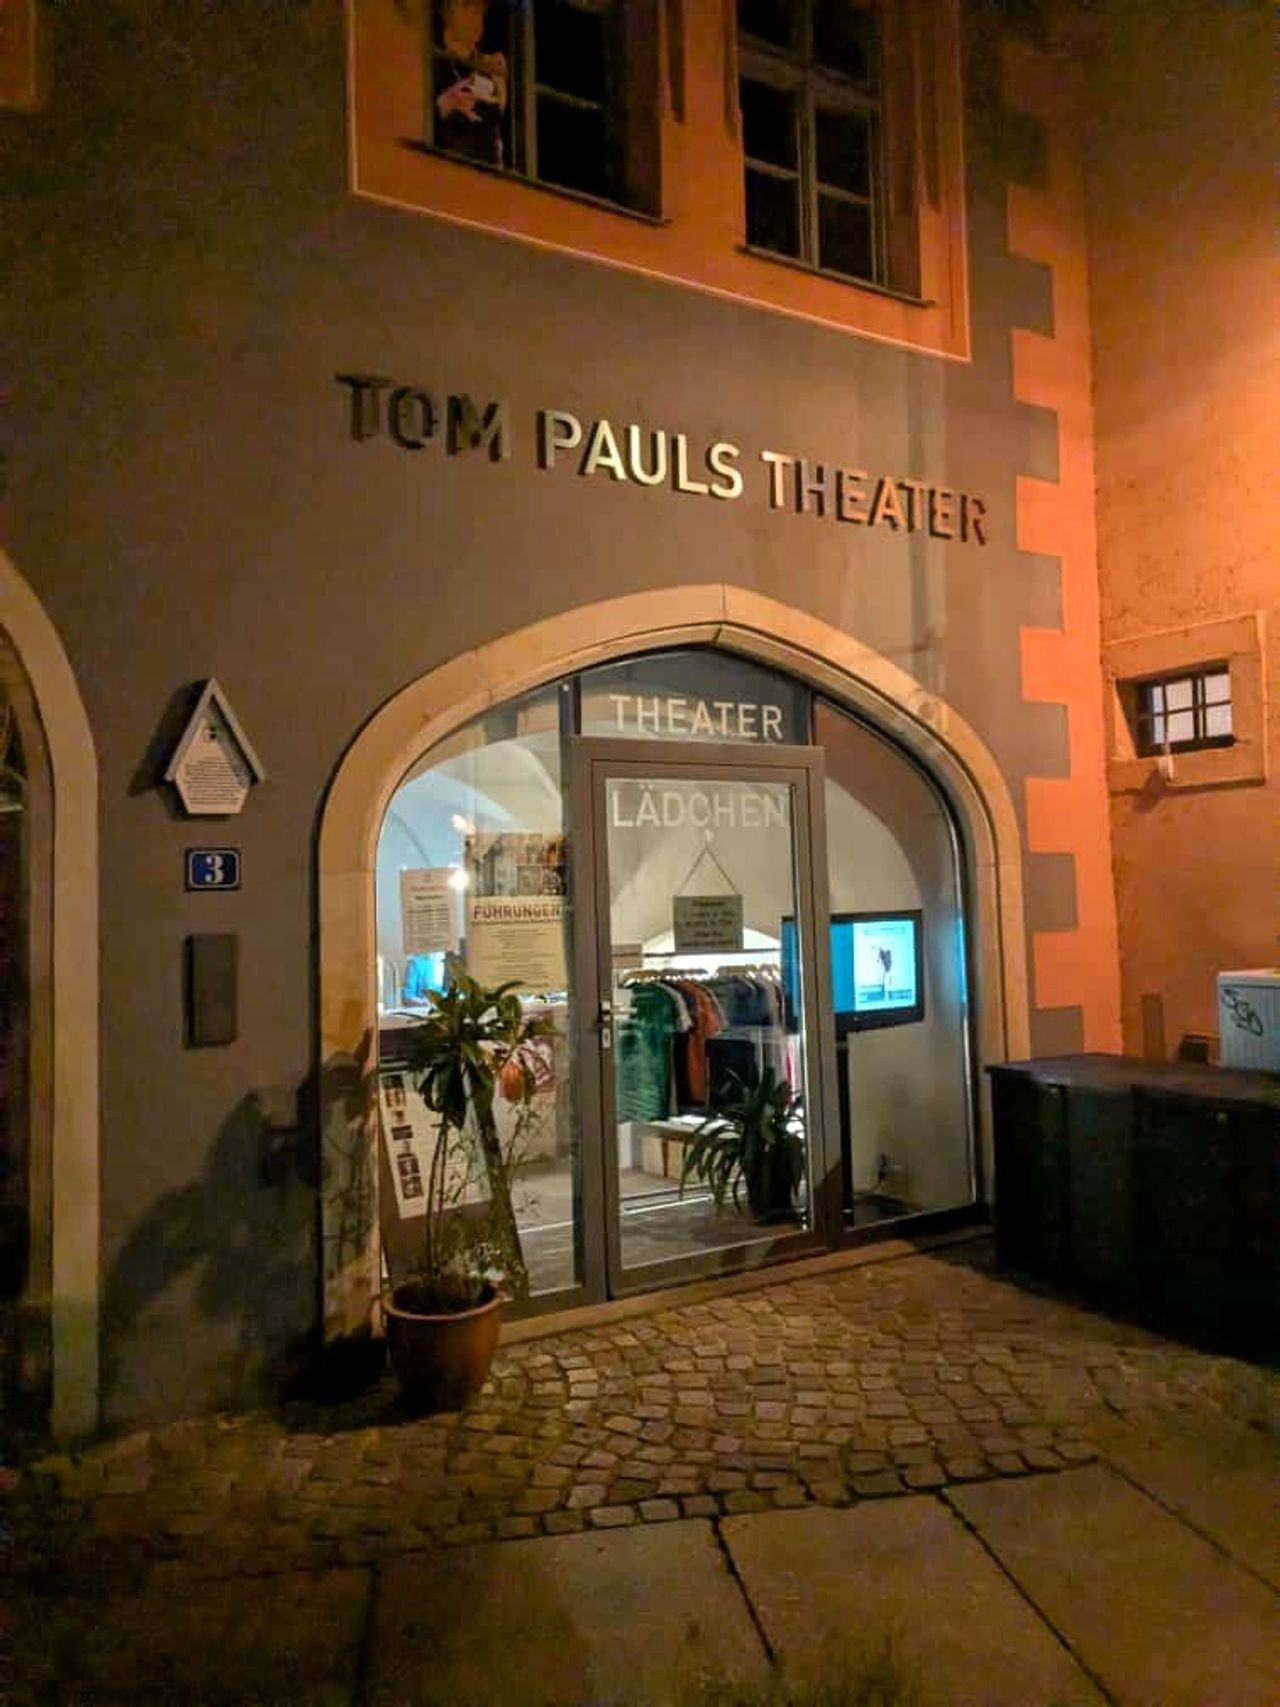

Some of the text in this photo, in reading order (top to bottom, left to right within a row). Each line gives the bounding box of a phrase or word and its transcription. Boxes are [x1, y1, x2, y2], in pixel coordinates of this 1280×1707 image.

[335, 374, 989, 546] TOM PAULS THEATER
[609, 694, 784, 740] THEATER
[611, 784, 788, 828] LÄDCHEN
[204, 854, 224, 884] 3
